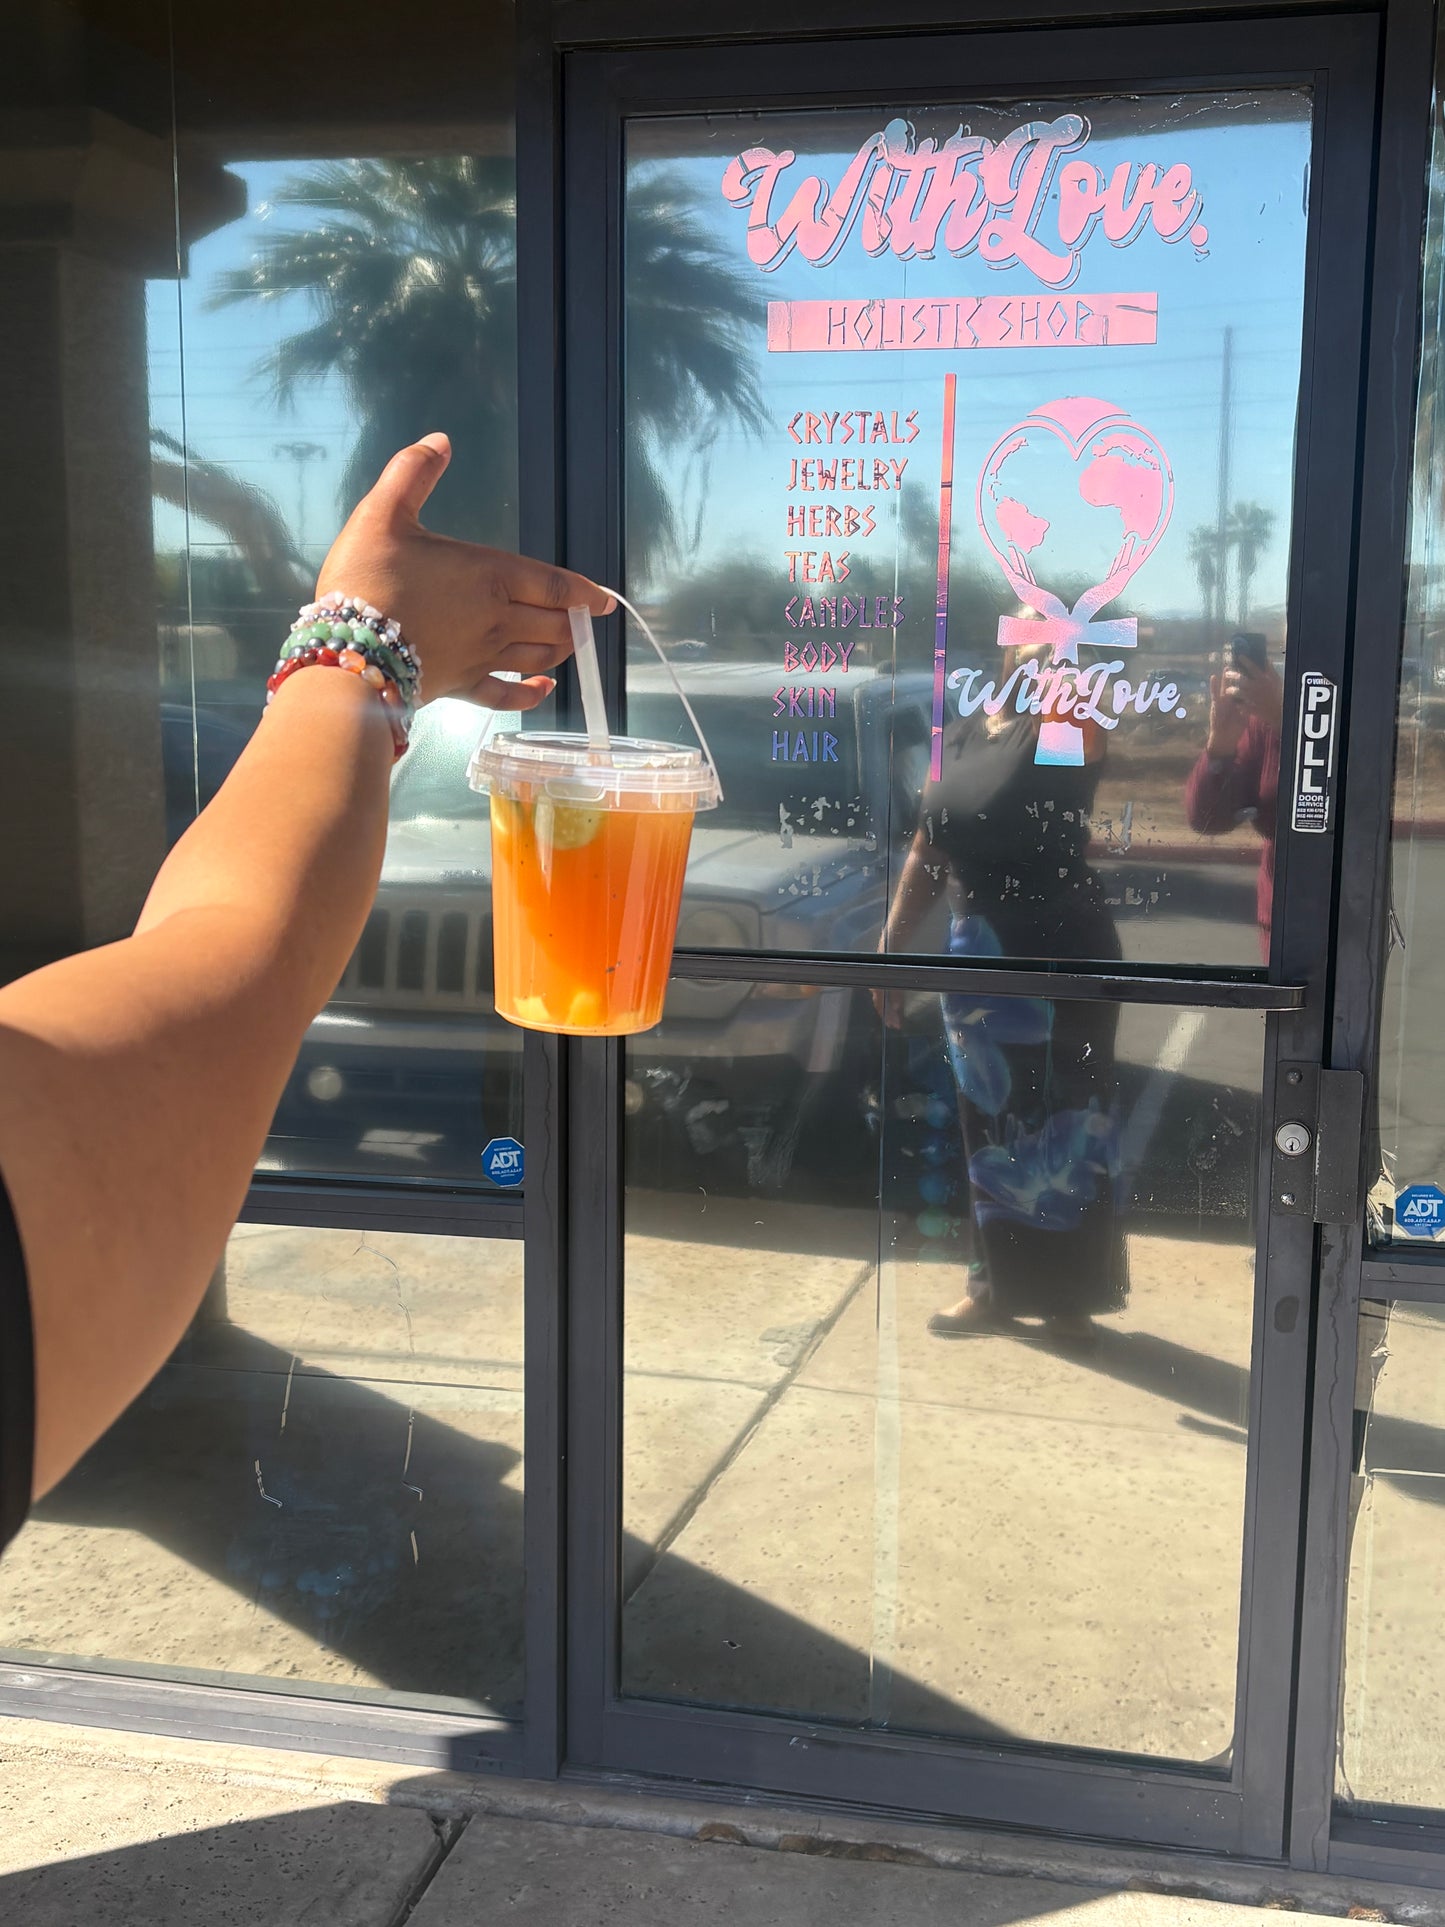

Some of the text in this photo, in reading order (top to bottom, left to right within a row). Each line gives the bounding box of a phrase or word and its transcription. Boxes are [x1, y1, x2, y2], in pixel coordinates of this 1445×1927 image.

[826, 300, 1094, 349] HOLISTIC SHOP
[787, 410, 921, 445] CRYSTALS
[786, 457, 909, 492] JEWELRY
[786, 504, 877, 538] HERBS
[784, 551, 851, 584] TEAS
[783, 596, 905, 629] CANDLES
[783, 641, 855, 673] BODY
[771, 686, 837, 719] SKIN
[771, 730, 839, 763] HAIR
[1302, 686, 1331, 793] PULL
[1298, 794, 1324, 802] DOOR
[490, 1151, 521, 1170] ADT
[1403, 1199, 1443, 1217] ADT
